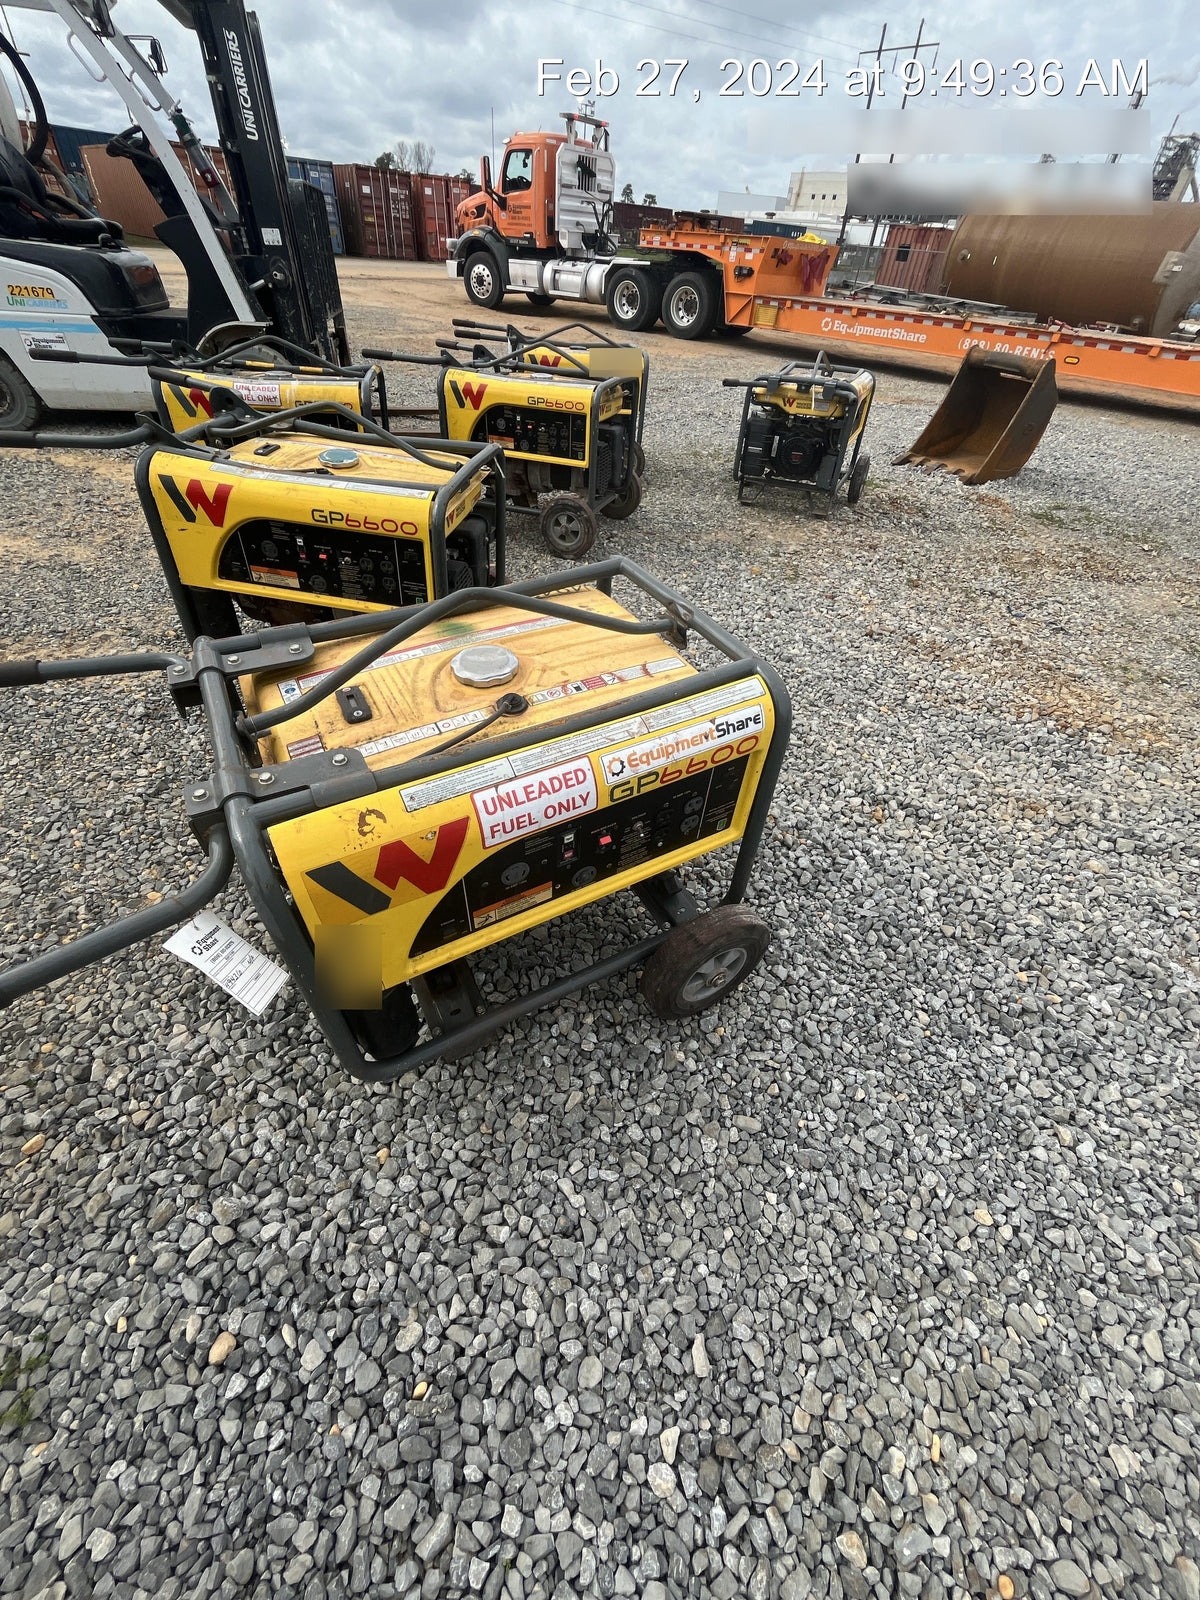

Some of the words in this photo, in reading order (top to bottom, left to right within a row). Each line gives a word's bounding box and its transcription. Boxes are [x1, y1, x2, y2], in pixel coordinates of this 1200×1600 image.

[223, 27, 259, 141] UNICARRIERS
[7, 284, 56, 299] 221679
[833, 320, 927, 343] EquipmentShare
[235, 384, 277, 393] UNLEADED
[257, 394, 279, 403] ONLY
[527, 395, 585, 411] GP6600
[311, 508, 418, 536] GP6600
[626, 711, 763, 768] EquipmentShare
[609, 735, 759, 803] GP6600
[481, 768, 588, 816] UNLEADED
[490, 812, 539, 840] FUEL
[543, 791, 591, 820] ONLY
[196, 925, 221, 946] Equipment
[202, 938, 220, 952] Share
